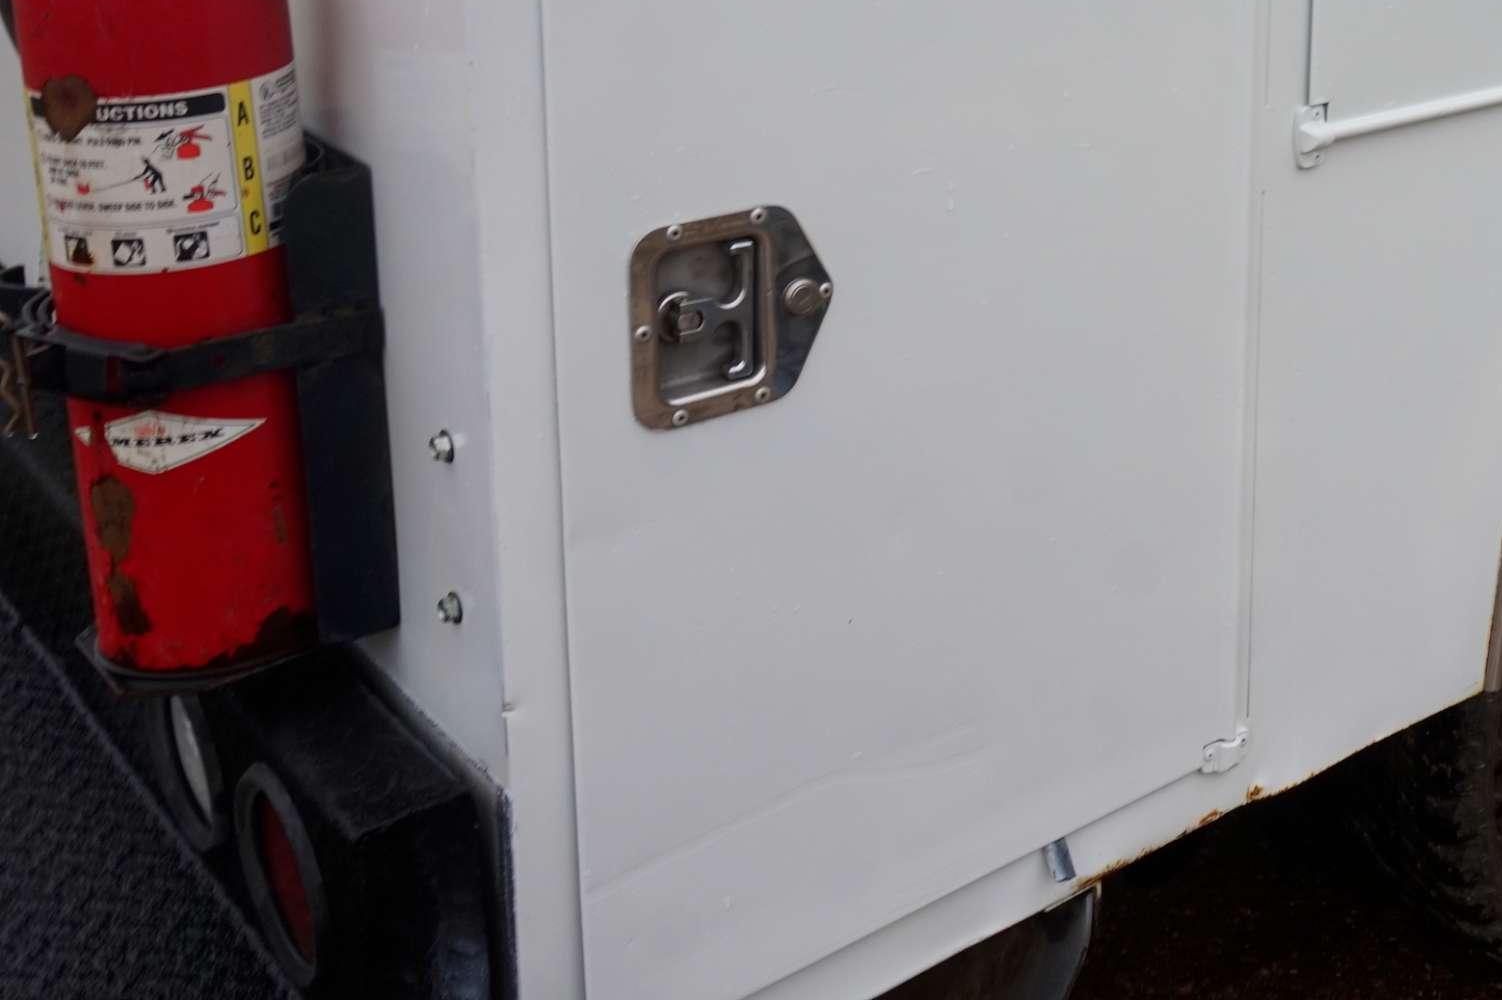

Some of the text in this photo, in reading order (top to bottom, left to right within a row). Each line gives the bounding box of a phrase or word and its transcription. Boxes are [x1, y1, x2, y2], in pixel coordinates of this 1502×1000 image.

[96, 100, 188, 121] UCTIONS
[237, 101, 249, 127] A
[243, 156, 255, 181] B
[250, 210, 261, 235] C
